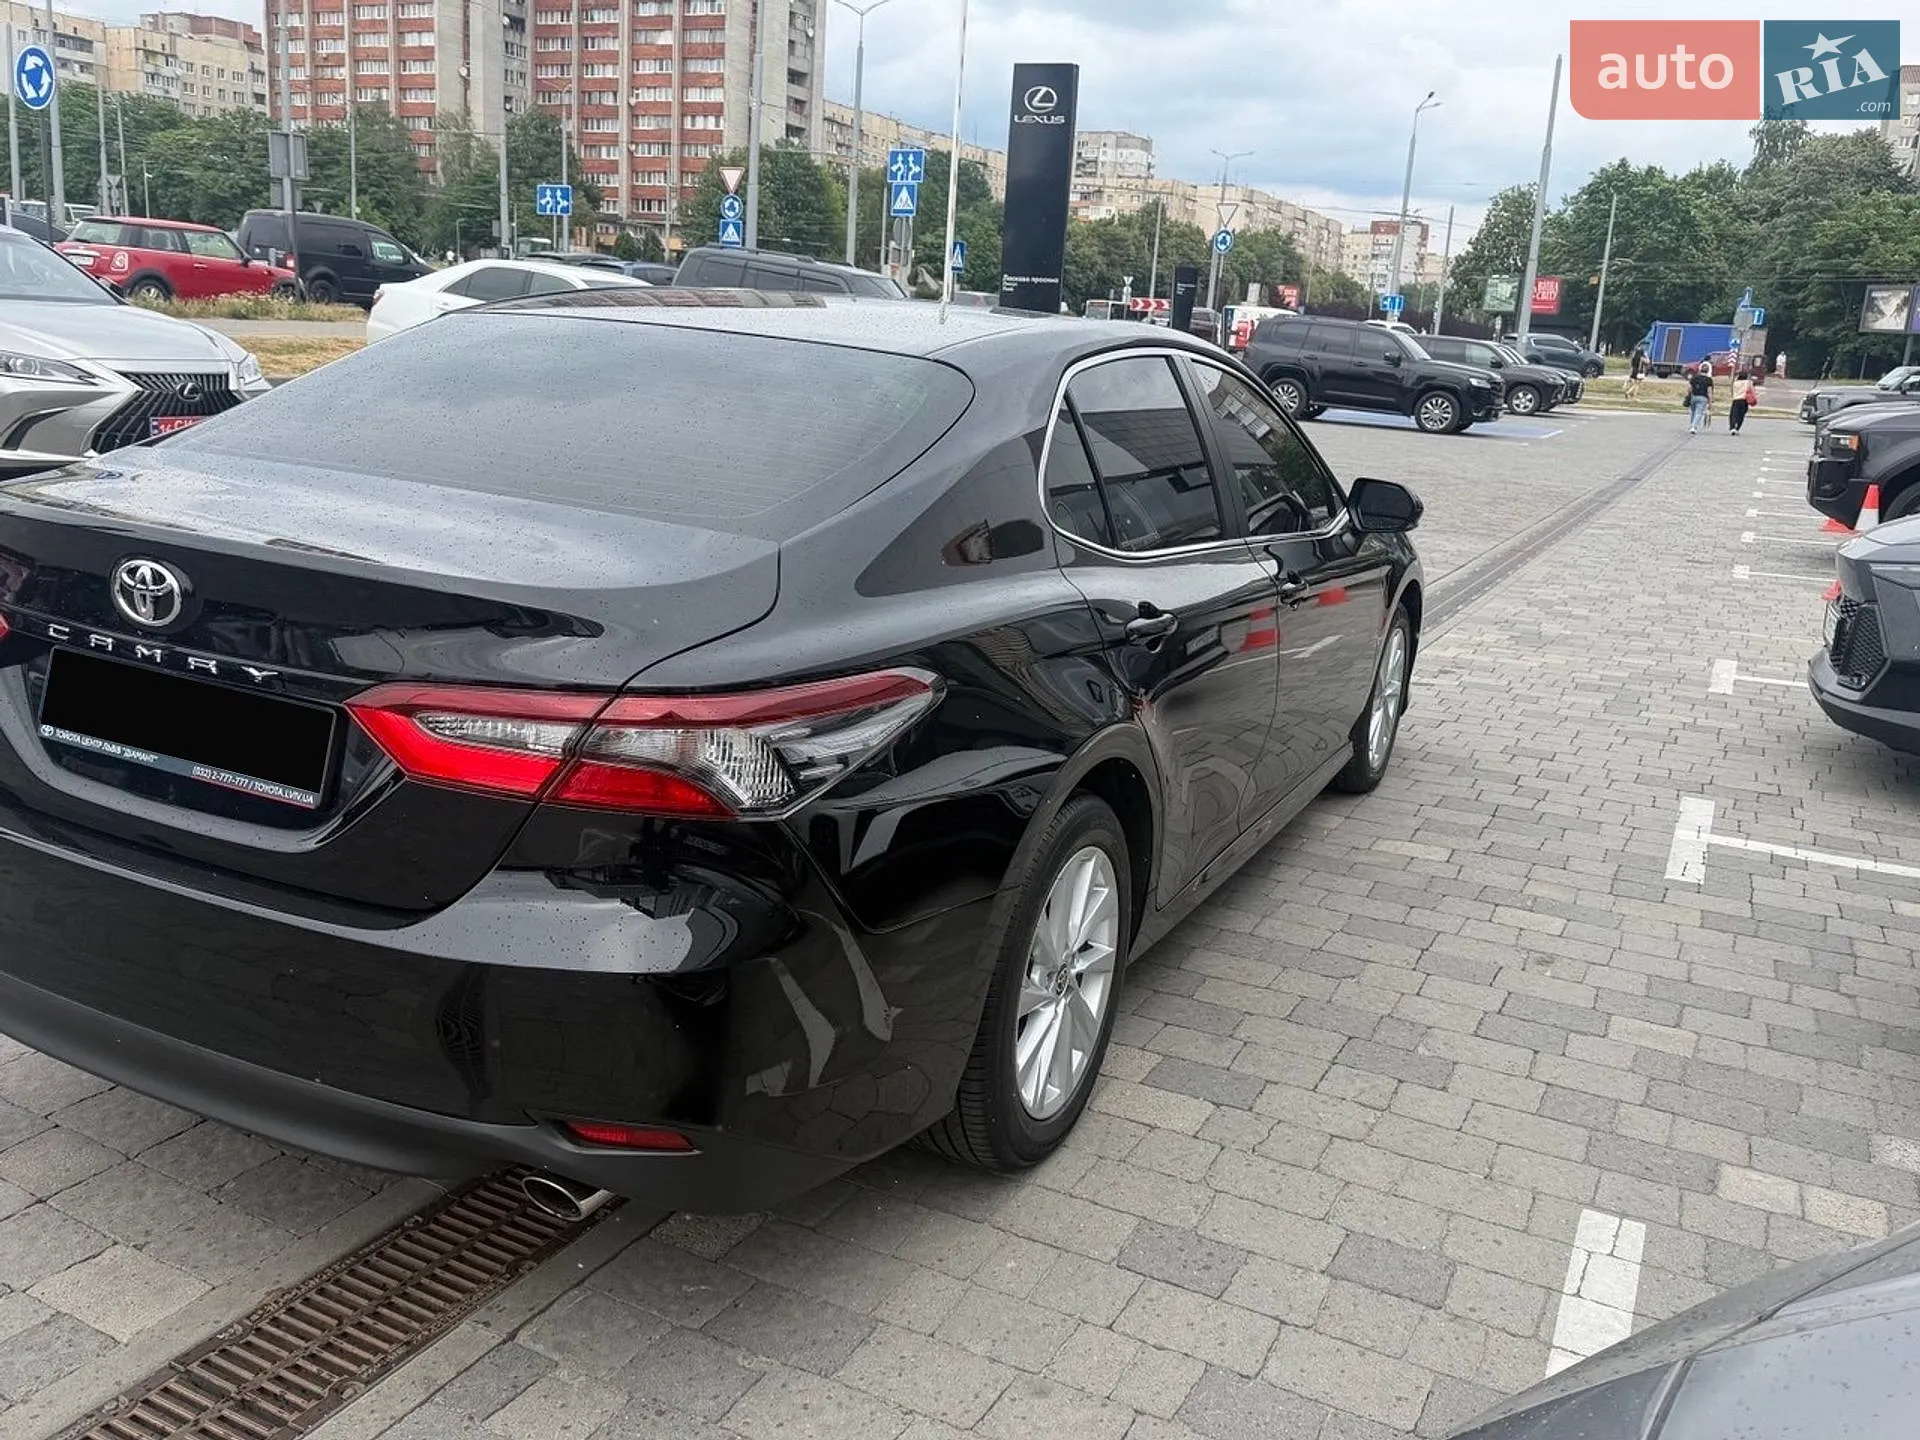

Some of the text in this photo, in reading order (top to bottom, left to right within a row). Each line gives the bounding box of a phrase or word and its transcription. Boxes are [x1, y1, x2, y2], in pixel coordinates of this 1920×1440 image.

[1014, 115, 1065, 124] LEXUS
[47, 623, 279, 683] CAMRY
[212, 769, 248, 787] 2-777-777
